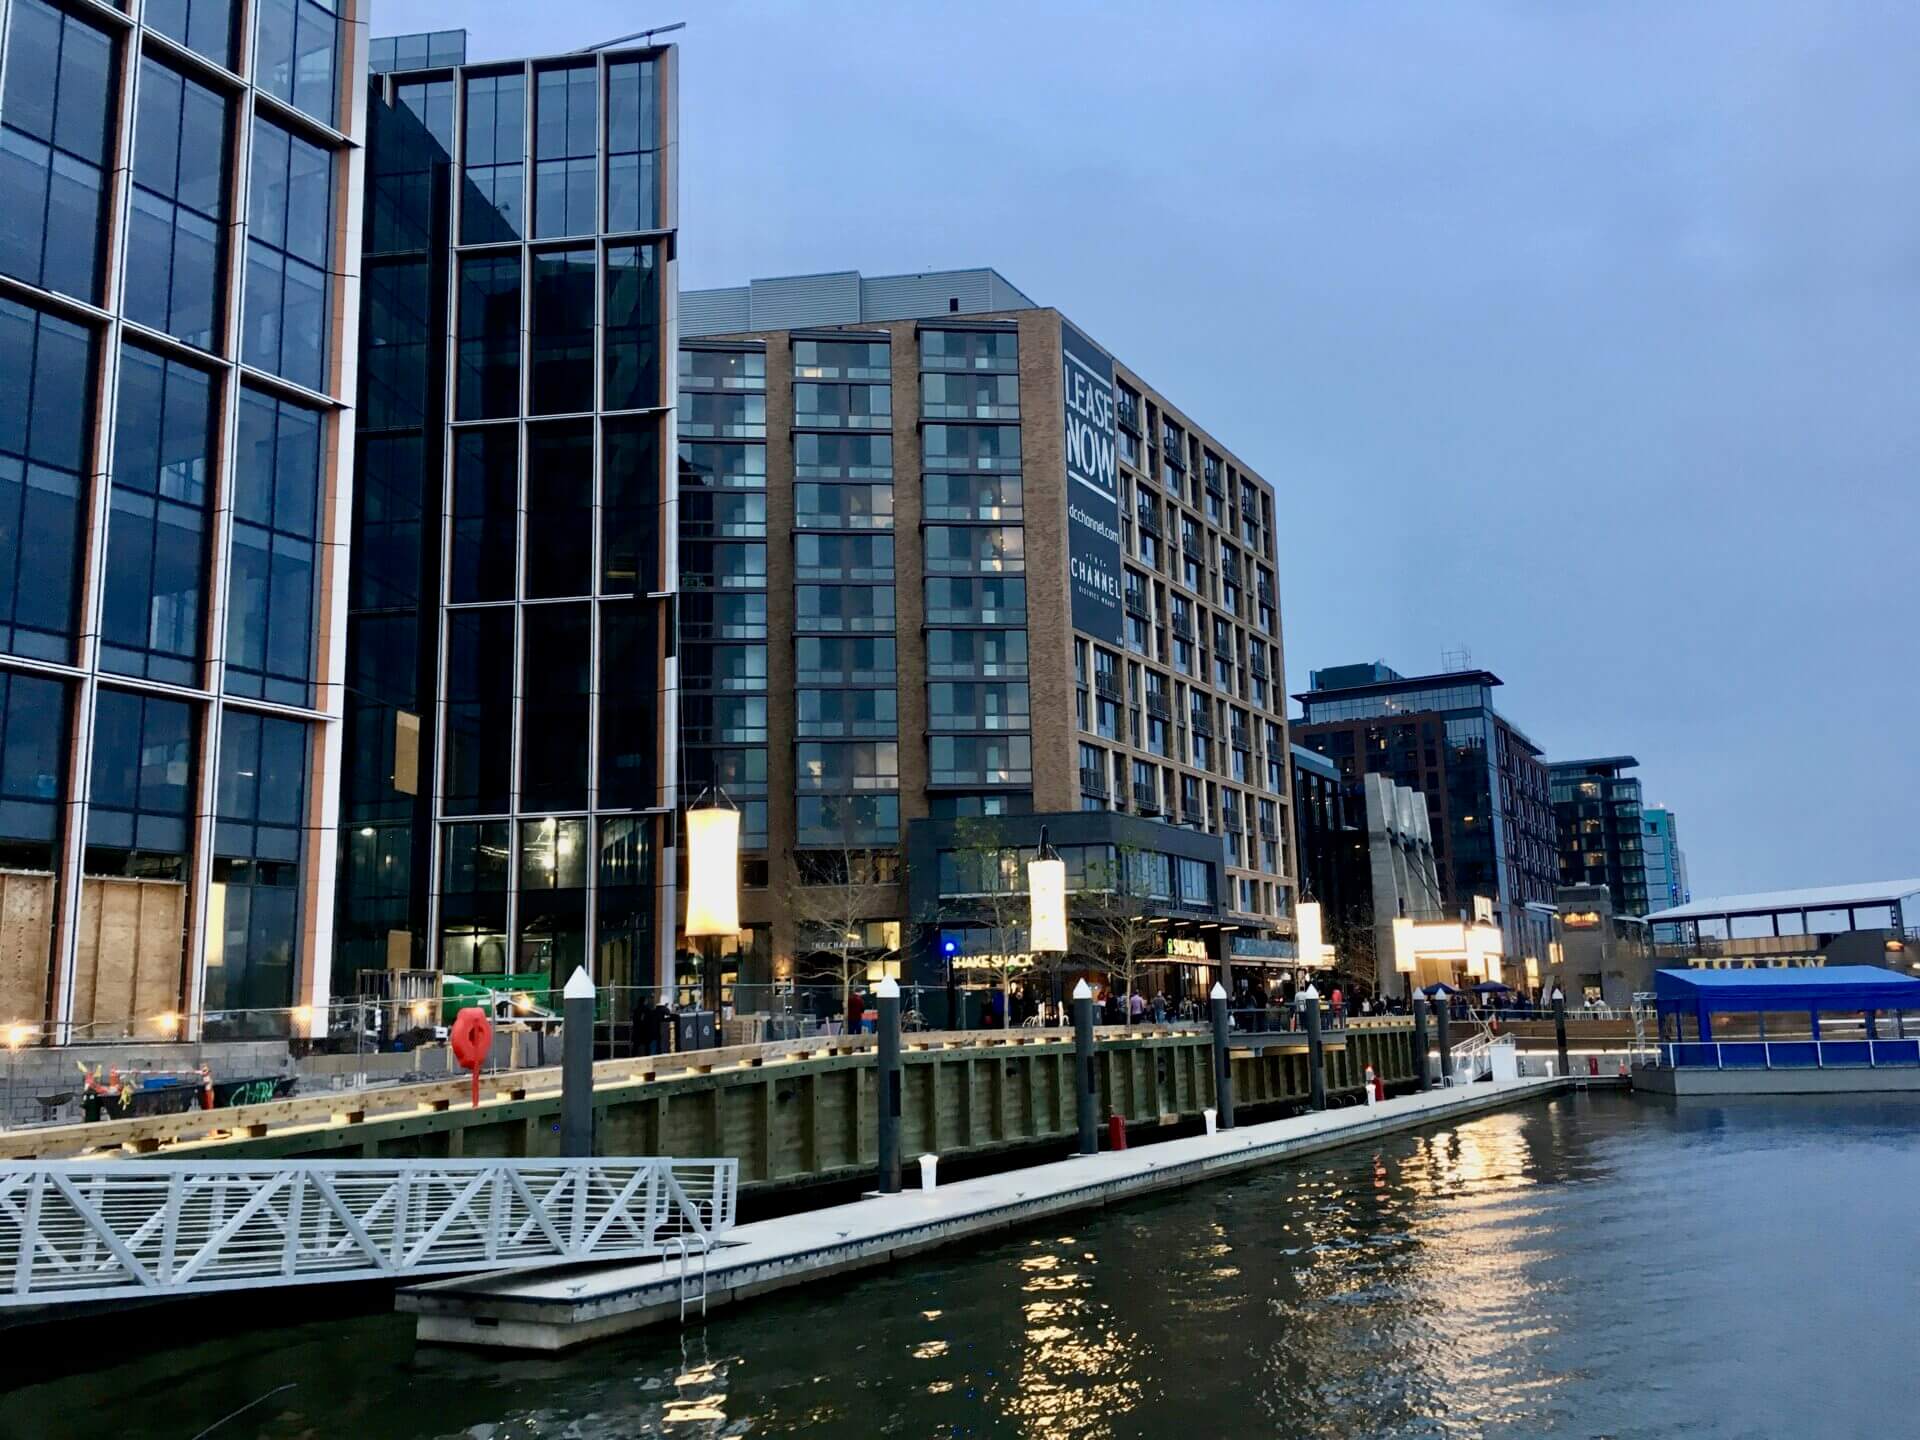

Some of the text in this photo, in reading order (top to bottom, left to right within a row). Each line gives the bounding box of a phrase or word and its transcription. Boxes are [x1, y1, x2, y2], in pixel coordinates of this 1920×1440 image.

[1064, 364, 1114, 435] LEASE
[1067, 412, 1114, 488] NOW
[1069, 503, 1119, 544] dcchannel.com
[1071, 557, 1120, 599] CHANNEL
